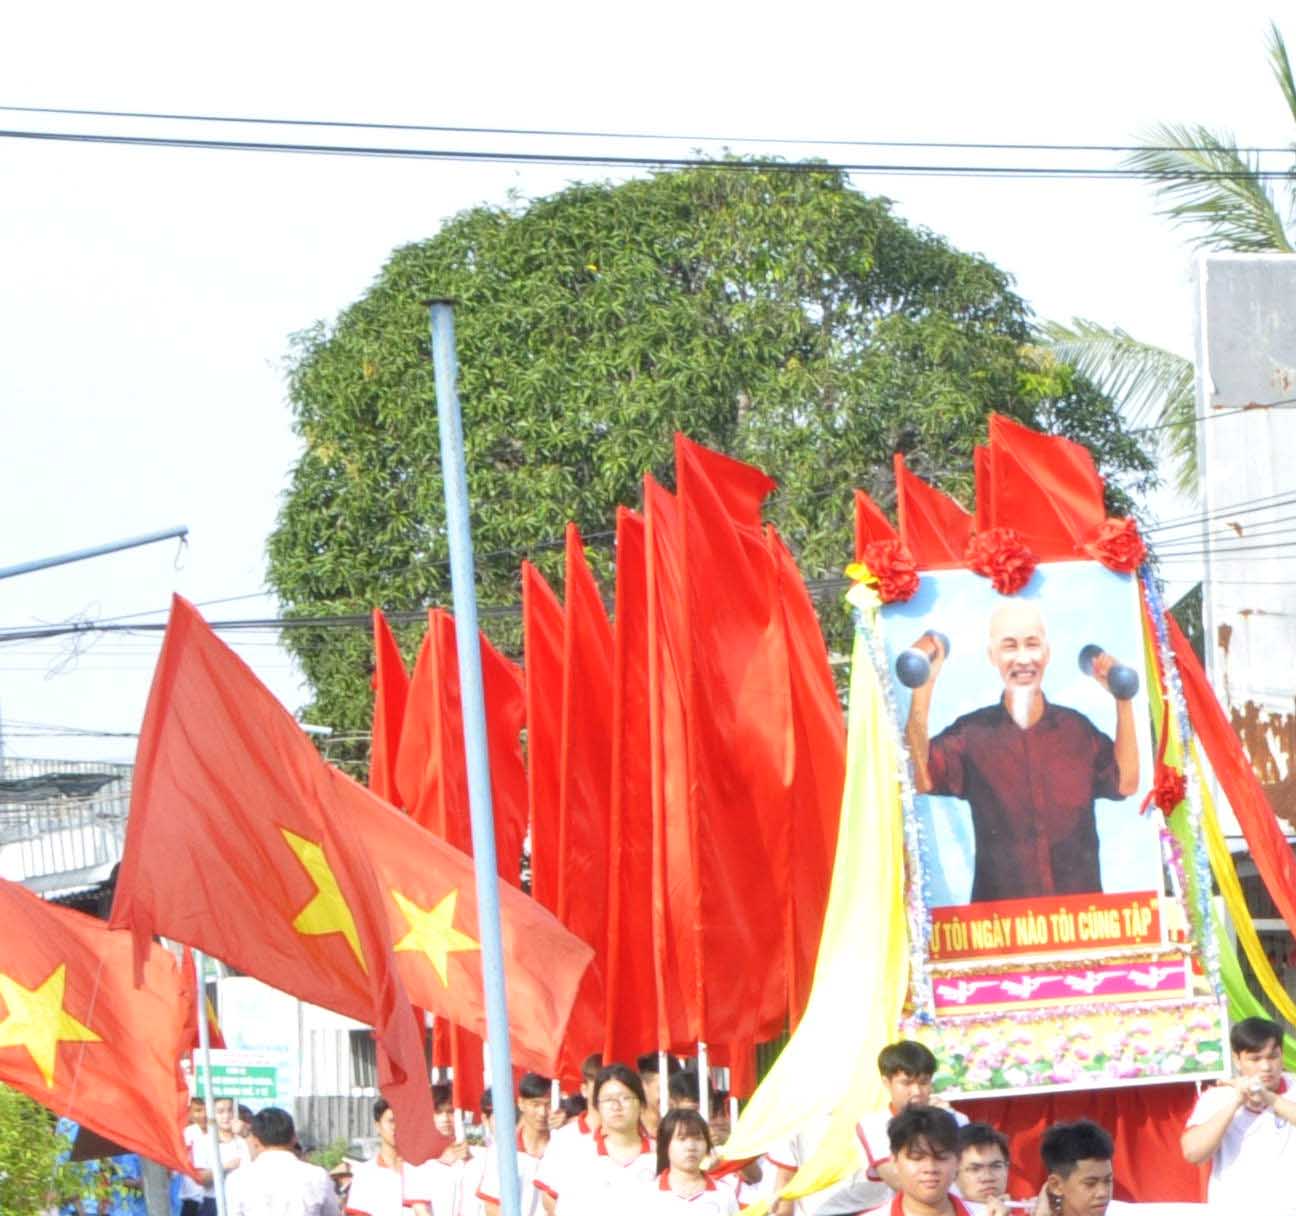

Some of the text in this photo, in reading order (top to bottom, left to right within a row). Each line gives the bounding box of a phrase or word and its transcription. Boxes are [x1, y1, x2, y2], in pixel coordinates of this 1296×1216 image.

[944, 917, 968, 952] TÔI
[970, 912, 1013, 950] NGÀY
[1015, 909, 1049, 946] NÀO
[1050, 906, 1076, 942] TÔI
[1077, 905, 1121, 940] CŨNG
